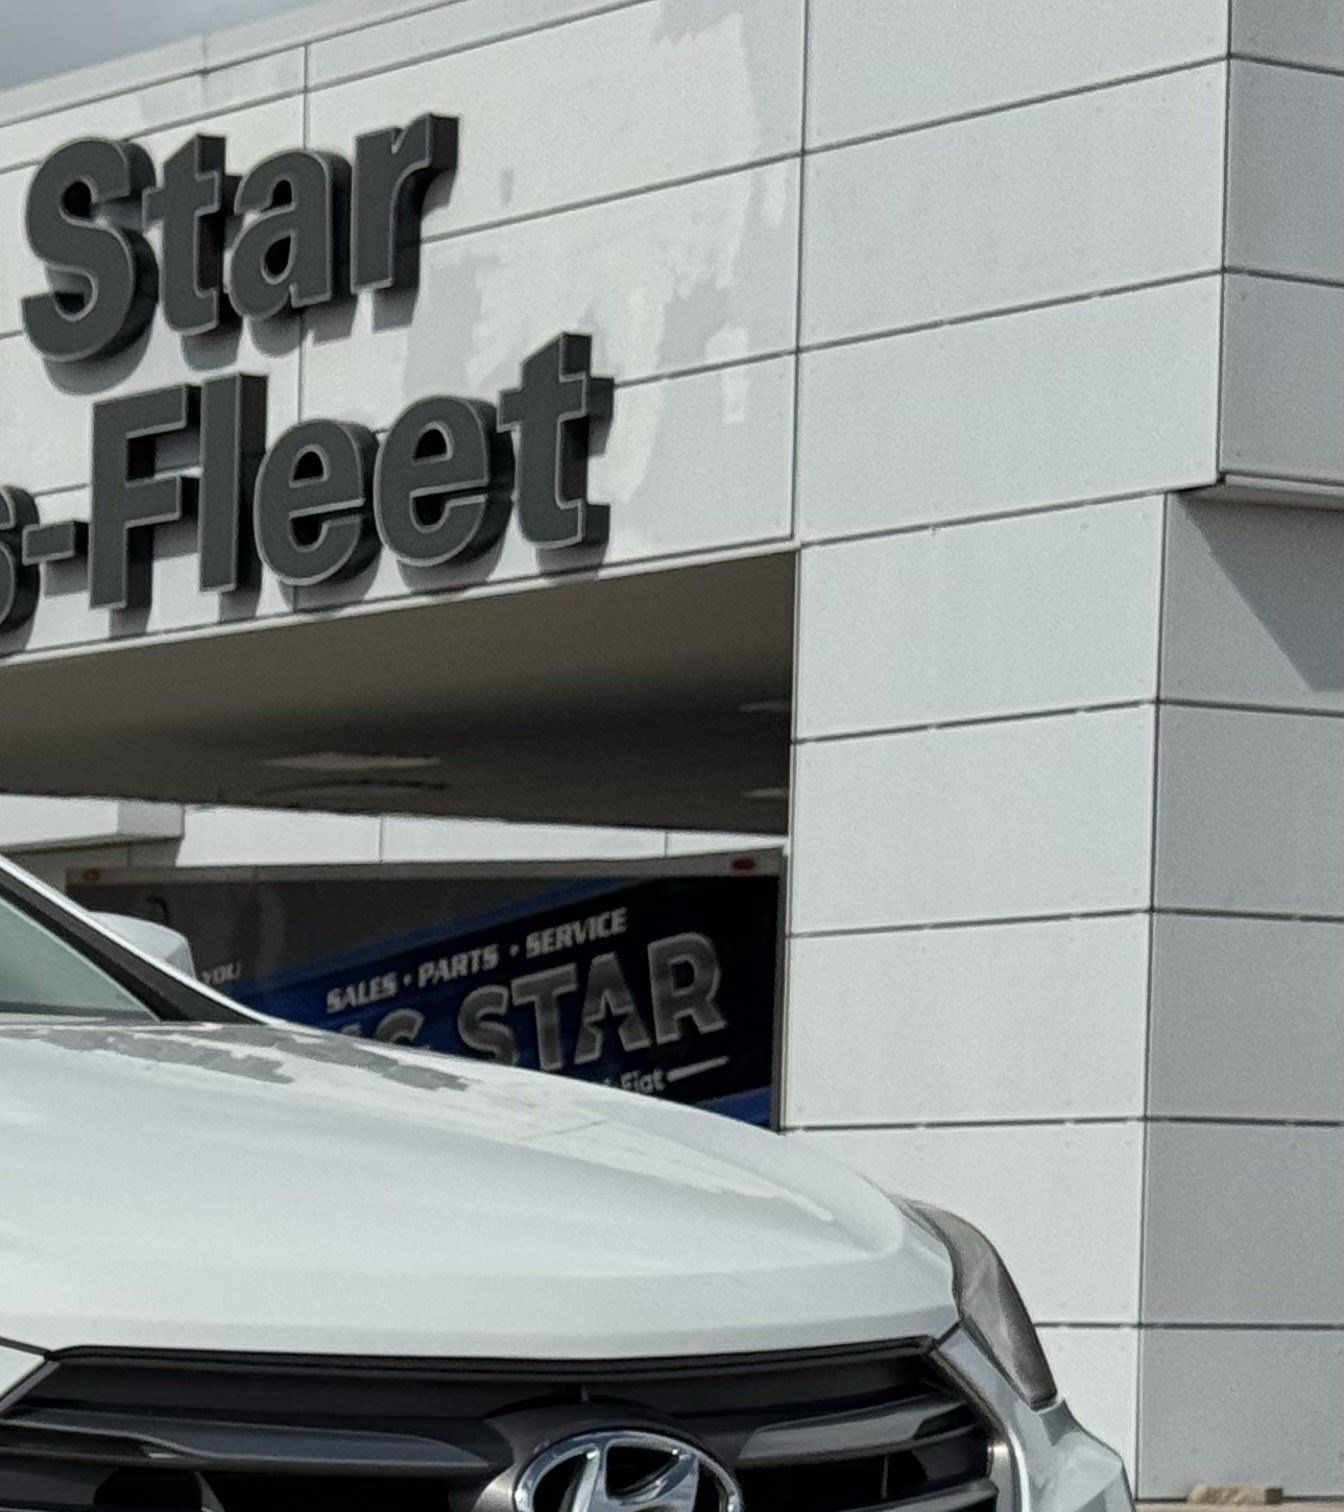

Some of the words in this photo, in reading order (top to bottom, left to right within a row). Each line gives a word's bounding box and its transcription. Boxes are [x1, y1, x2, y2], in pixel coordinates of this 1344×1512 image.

[21, 112, 459, 362] Star
[325, 970, 398, 1014] SALES
[417, 943, 500, 988] PARTS
[525, 907, 629, 958] SERVICE
[457, 932, 728, 1071] STAR
